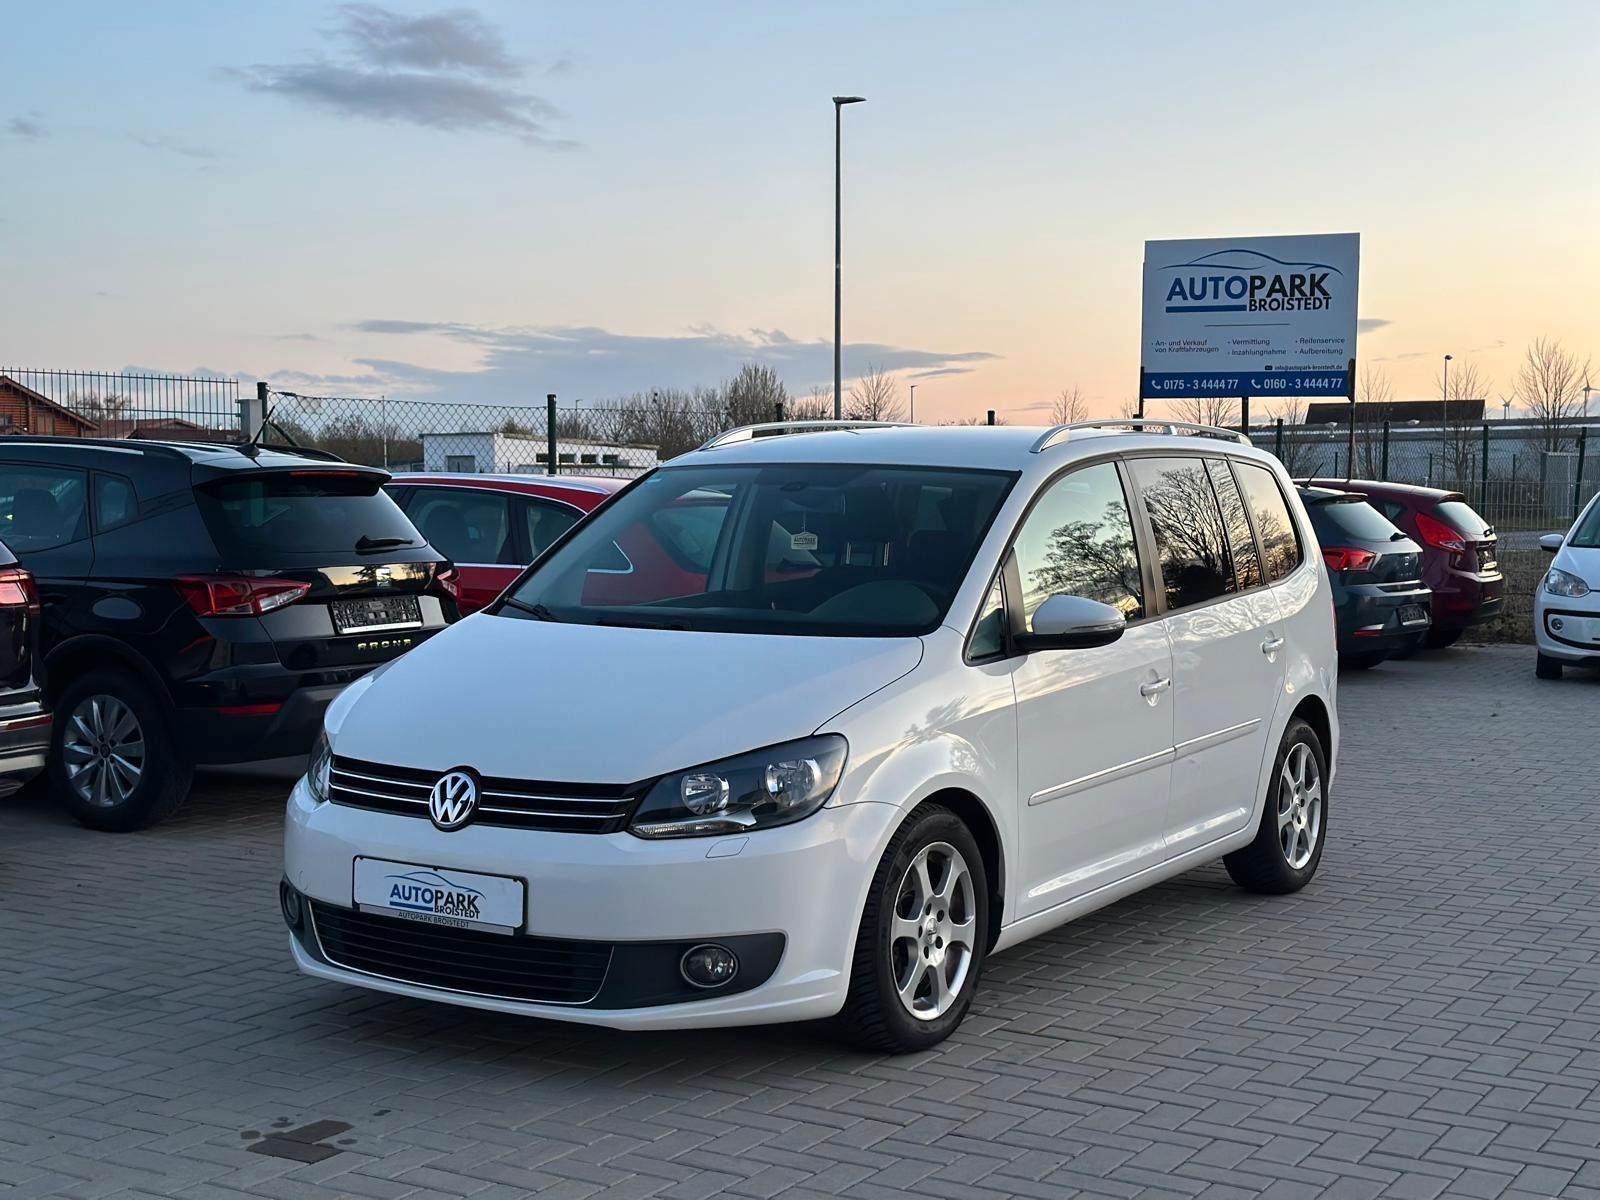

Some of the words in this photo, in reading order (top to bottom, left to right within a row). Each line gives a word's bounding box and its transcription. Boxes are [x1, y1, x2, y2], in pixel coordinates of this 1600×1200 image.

[1165, 272, 1331, 301] AUTOPARK
[1248, 296, 1332, 312] BROISTEDT
[1231, 338, 1271, 346] Vermittlung
[1168, 346, 1220, 354] Kraftfahrzeugen
[1163, 379, 1185, 390] 0175
[1263, 378, 1287, 389] 0160
[389, 884, 480, 911] AUTOPARK
[434, 905, 480, 919] BROISTEDT
[398, 911, 432, 923] AUTOPARK
[433, 915, 470, 929] BROISTEDT
